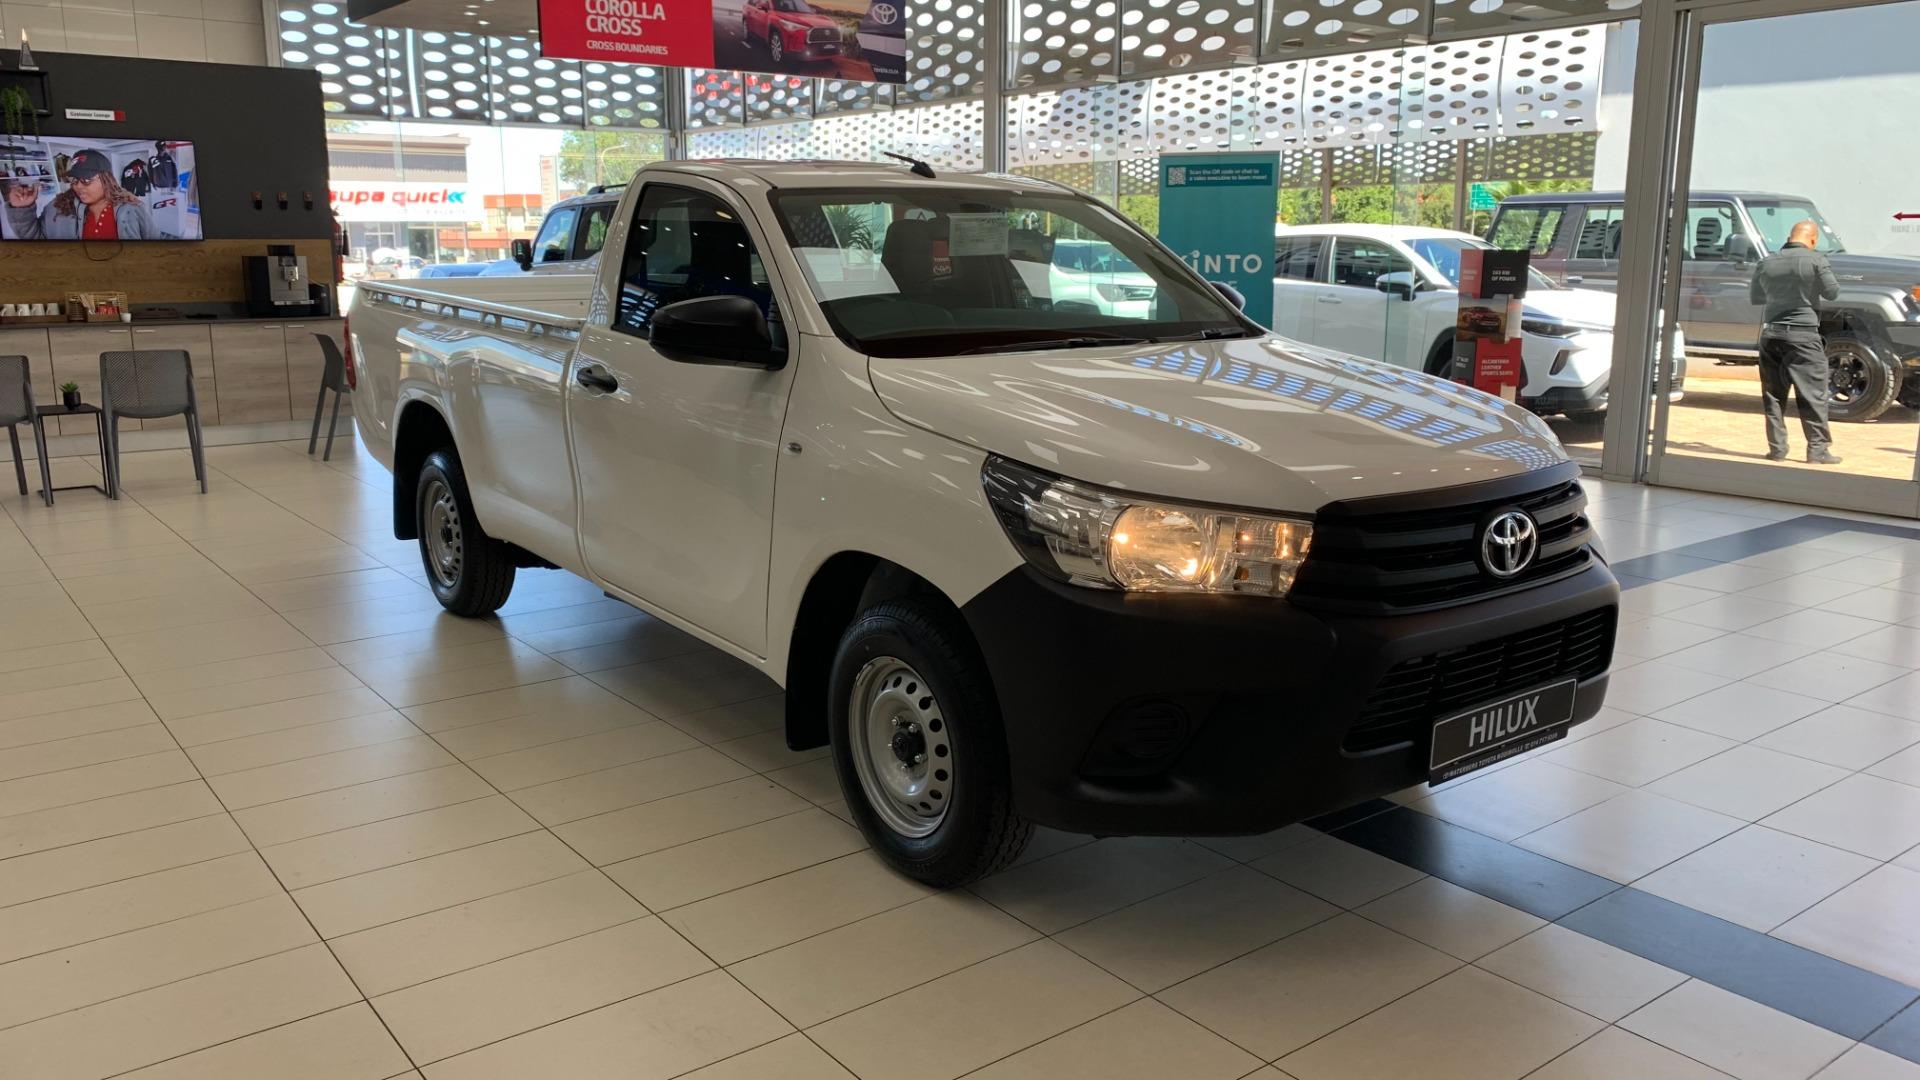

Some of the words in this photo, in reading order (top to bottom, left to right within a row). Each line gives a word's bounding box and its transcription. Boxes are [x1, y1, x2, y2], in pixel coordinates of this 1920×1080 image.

[585, 0, 666, 20] COROLLA
[586, 14, 643, 36] CROSS
[586, 40, 615, 51] CROSS
[615, 41, 668, 55] BOUNDARIES
[152, 198, 177, 210] GR
[1468, 695, 1540, 748] HILUX
